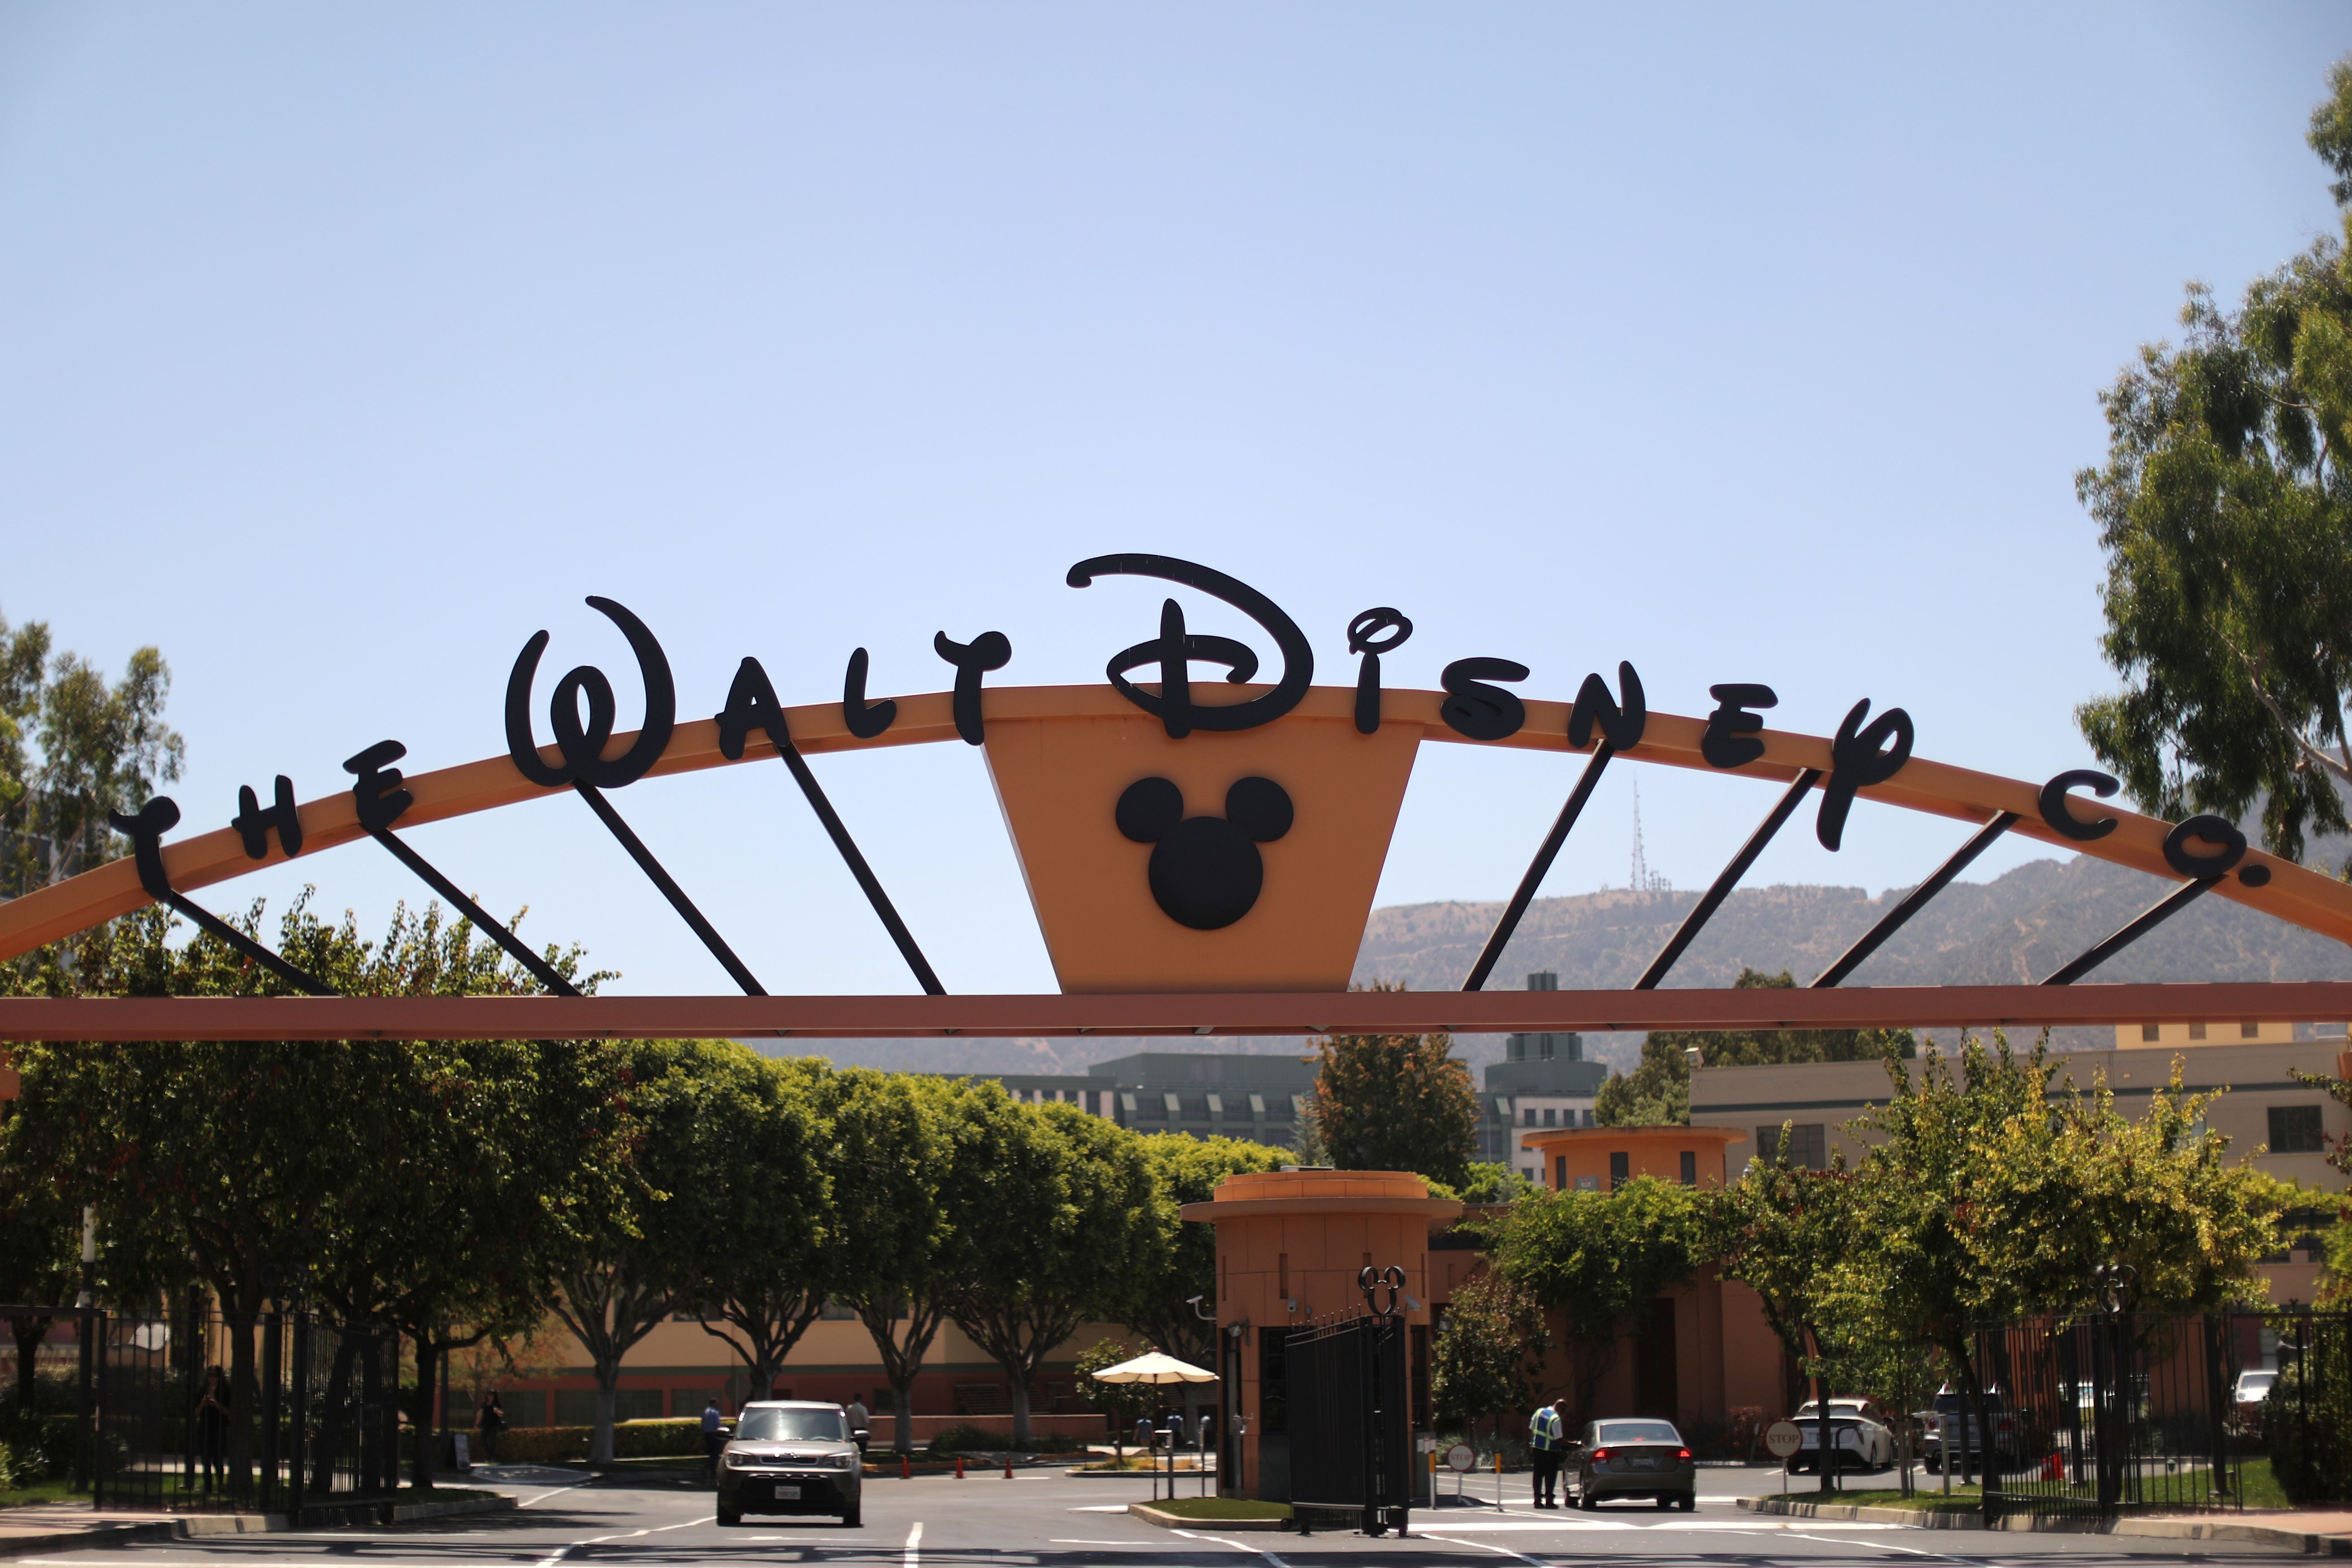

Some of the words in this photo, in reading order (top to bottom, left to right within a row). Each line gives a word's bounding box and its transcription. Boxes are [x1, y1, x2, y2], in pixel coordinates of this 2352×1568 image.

[108, 739, 414, 901] THE
[505, 594, 1013, 789] WALT
[2039, 769, 2272, 888] CO.
[1769, 1434, 1799, 1443] STOP
